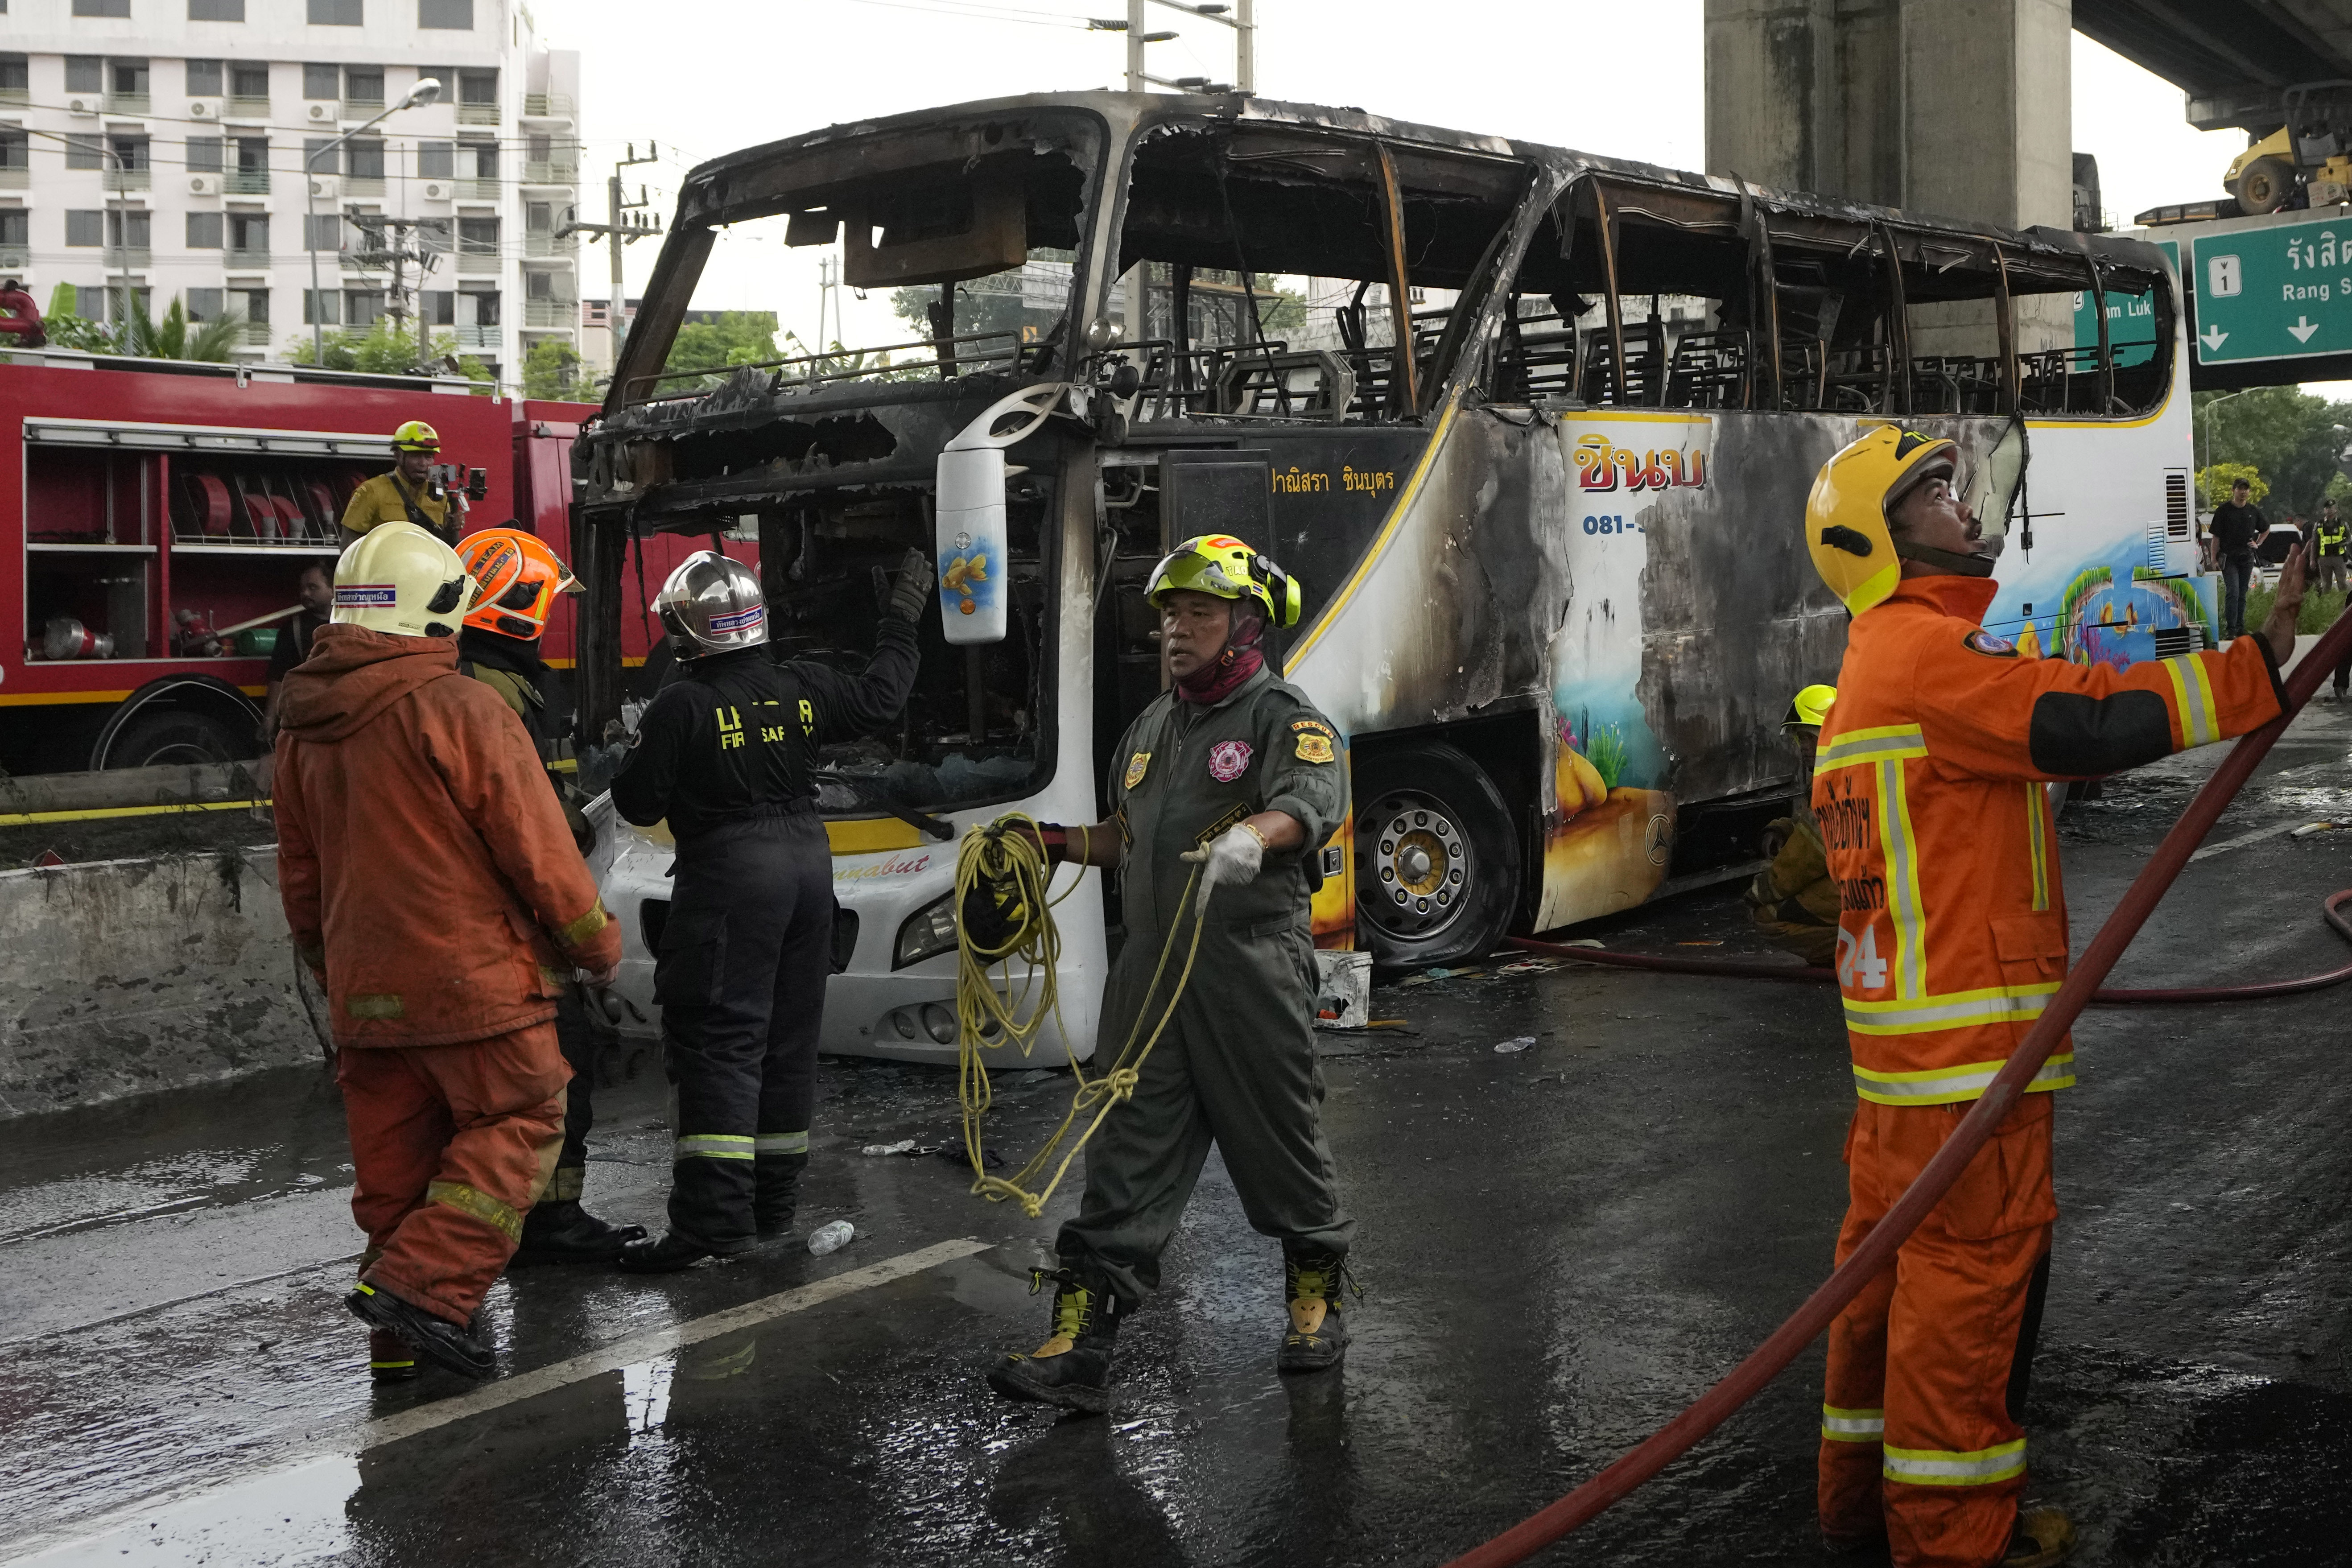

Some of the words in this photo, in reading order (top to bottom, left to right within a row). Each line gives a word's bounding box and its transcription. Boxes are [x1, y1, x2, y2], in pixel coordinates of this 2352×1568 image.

[2221, 275, 2228, 291] 1
[2283, 284, 2330, 301] Rang
[2128, 300, 2151, 317] Luk
[1342, 466, 1394, 498] ชินบุตร
[1583, 515, 1646, 535] 081-
[478, 541, 504, 564] TEAM
